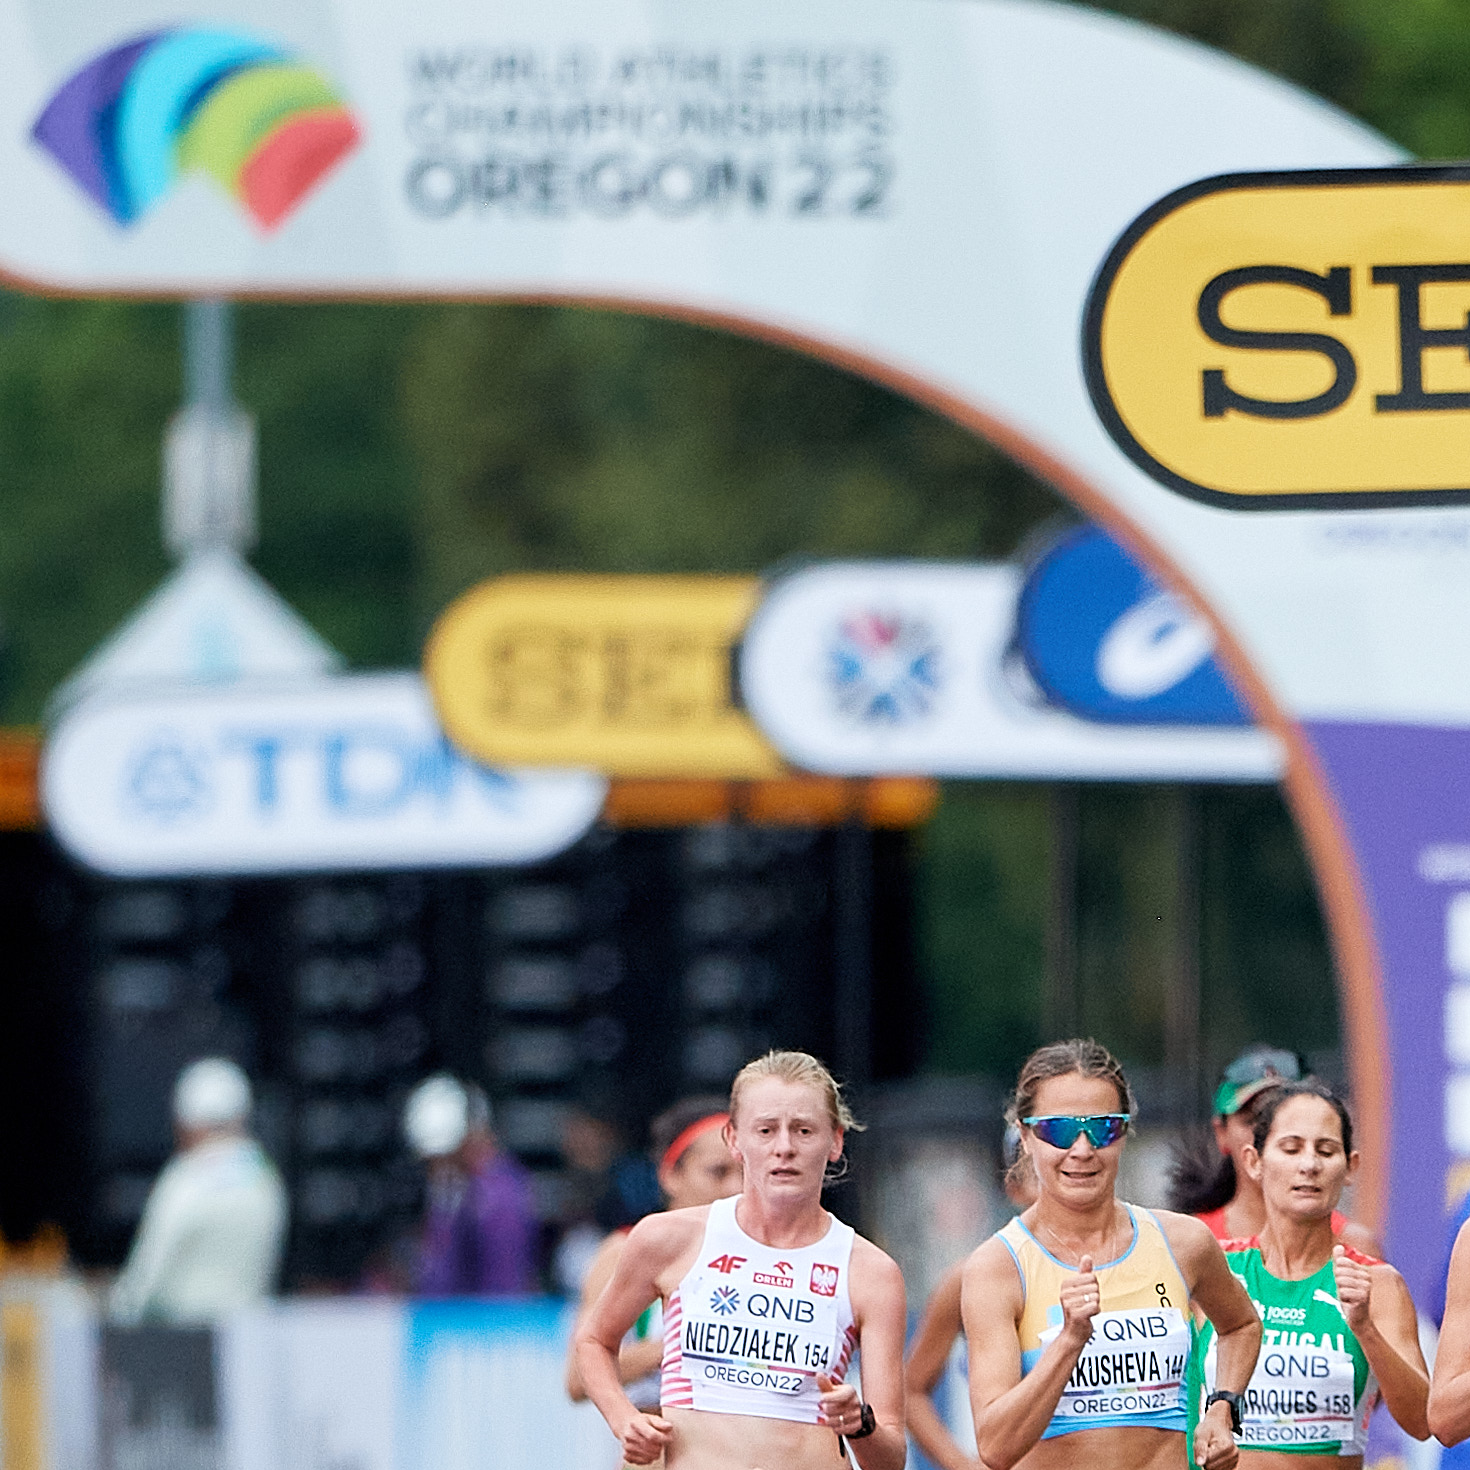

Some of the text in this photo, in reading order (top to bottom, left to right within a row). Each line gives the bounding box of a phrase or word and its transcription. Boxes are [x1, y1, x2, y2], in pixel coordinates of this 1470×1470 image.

[408, 50, 892, 90] WORLD ATHLETICS
[407, 99, 891, 140] CHAMPIONSHIPS
[708, 1254, 747, 1273] 4F
[754, 1274, 792, 1287] ORLEN
[747, 1293, 814, 1323] QNB
[1266, 1306, 1306, 1320] JOGOS
[1103, 1316, 1168, 1341] QNB
[686, 1321, 829, 1369] NIEDZIAŁEK 154
[704, 1364, 803, 1392] OREGON22
[1068, 1351, 1184, 1388] KUSHEVA 144
[1264, 1354, 1330, 1378] QNB
[1073, 1393, 1166, 1413] OREGON22
[1244, 1389, 1350, 1415] RIQUES 158
[1235, 1425, 1331, 1441] REGON22
